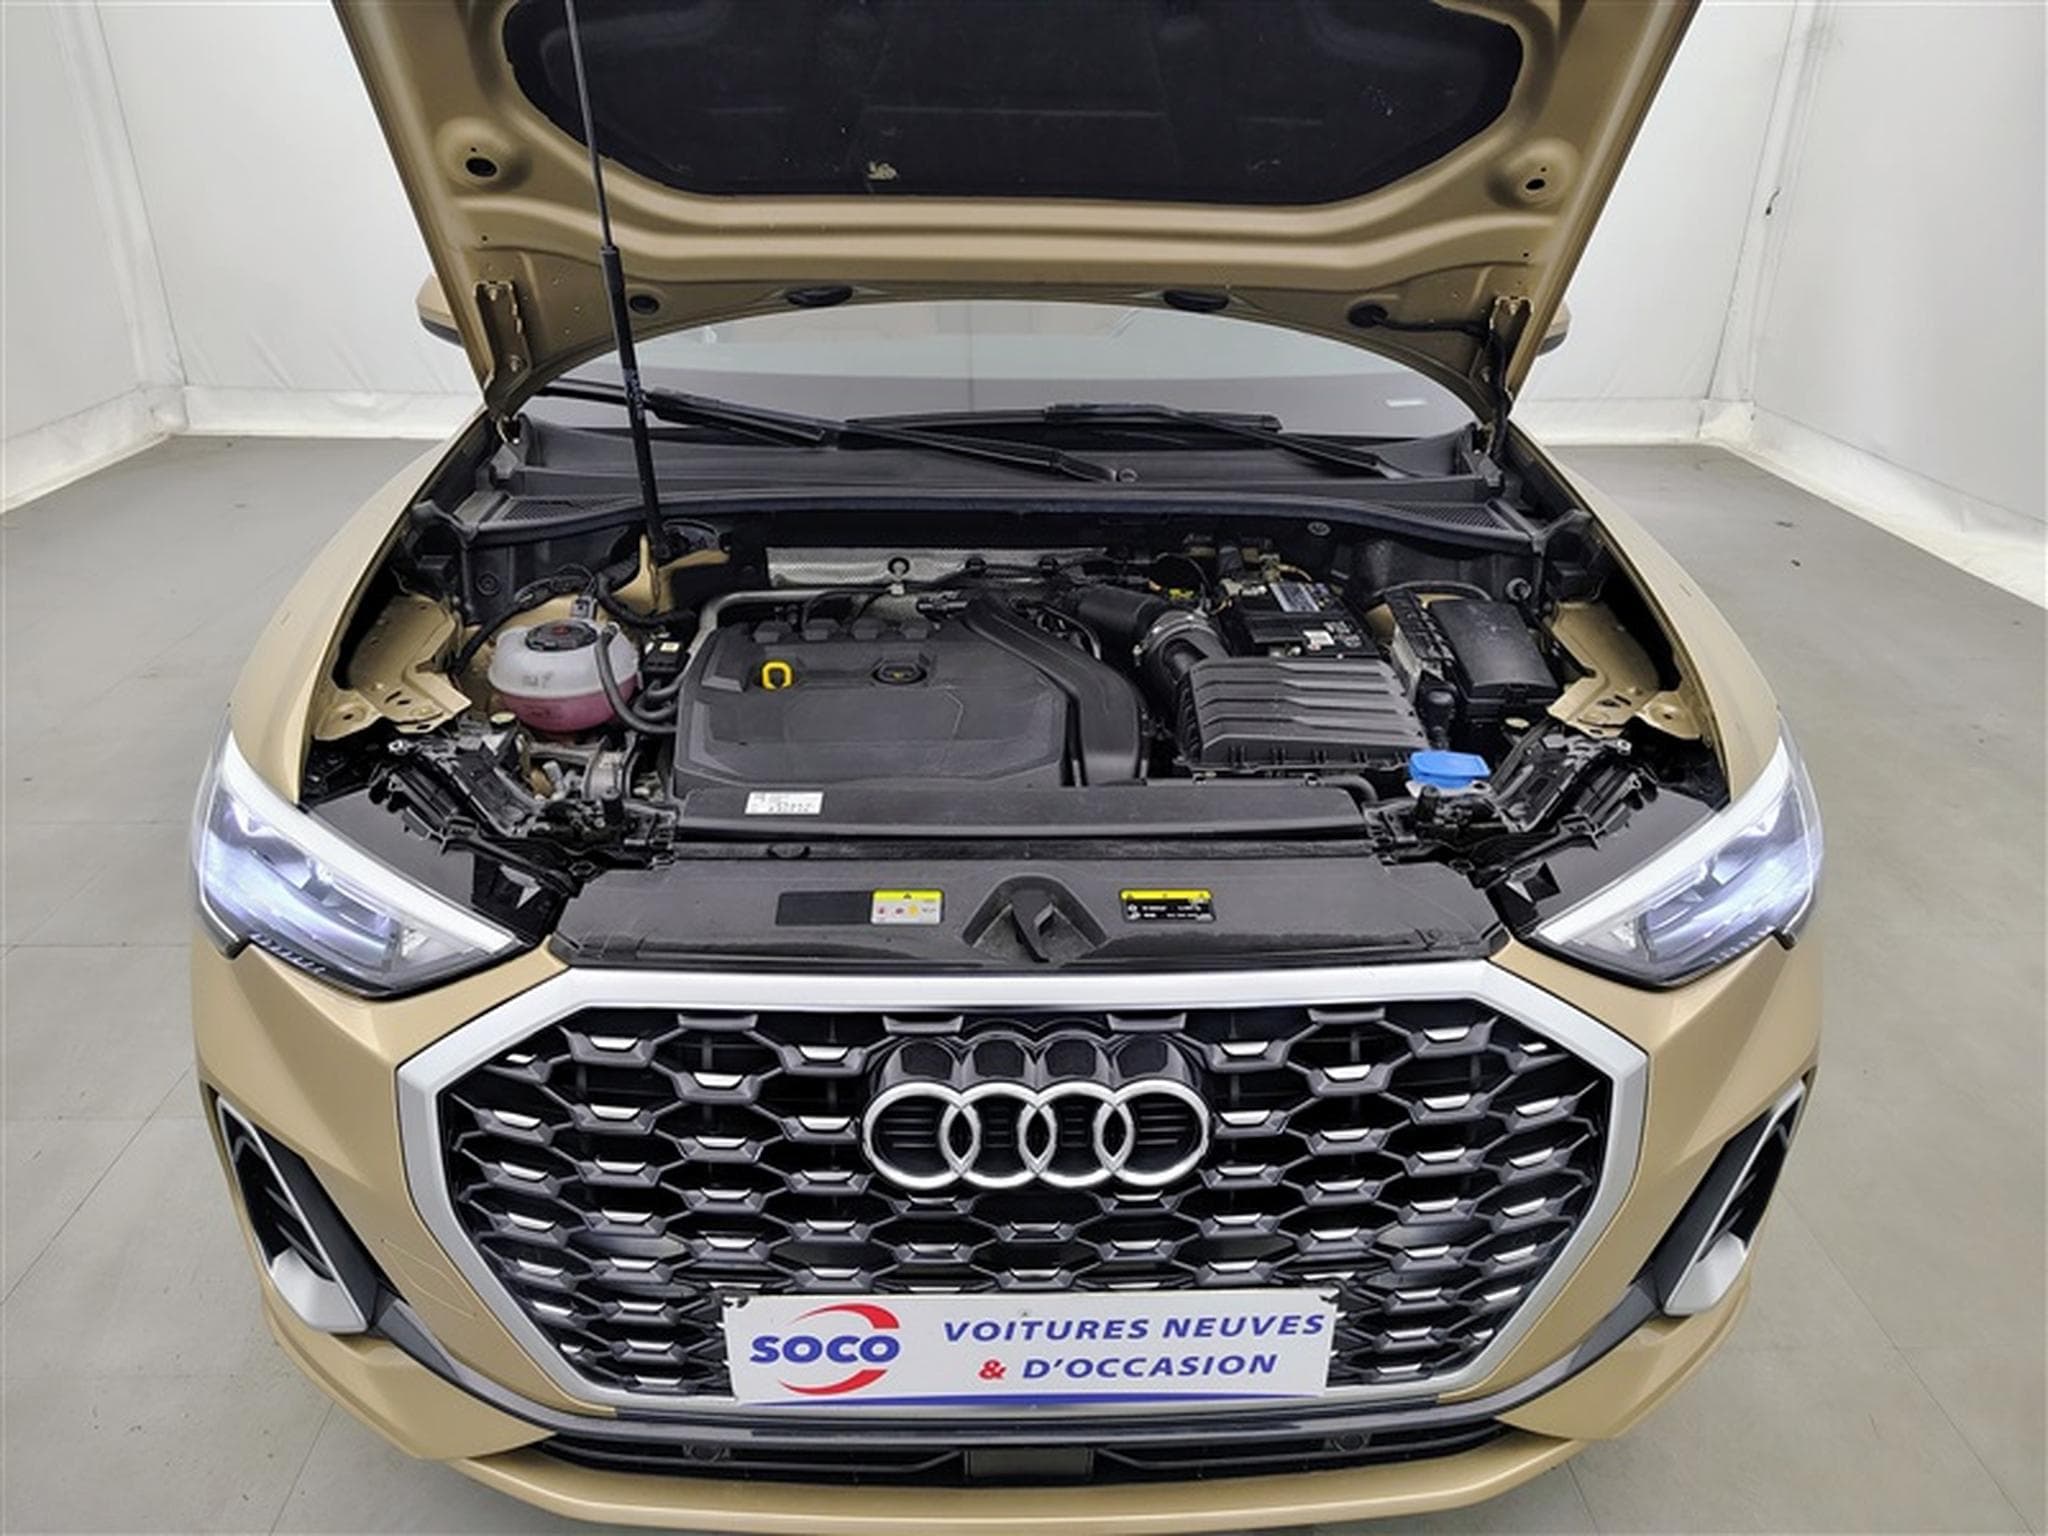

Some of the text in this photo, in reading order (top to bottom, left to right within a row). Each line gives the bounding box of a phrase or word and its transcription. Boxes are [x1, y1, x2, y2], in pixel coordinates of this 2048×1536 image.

[944, 1314, 1324, 1343] VOITURES NEUVES
[750, 1334, 902, 1365] SOCO
[979, 1353, 1278, 1381] & D'OCCASION
